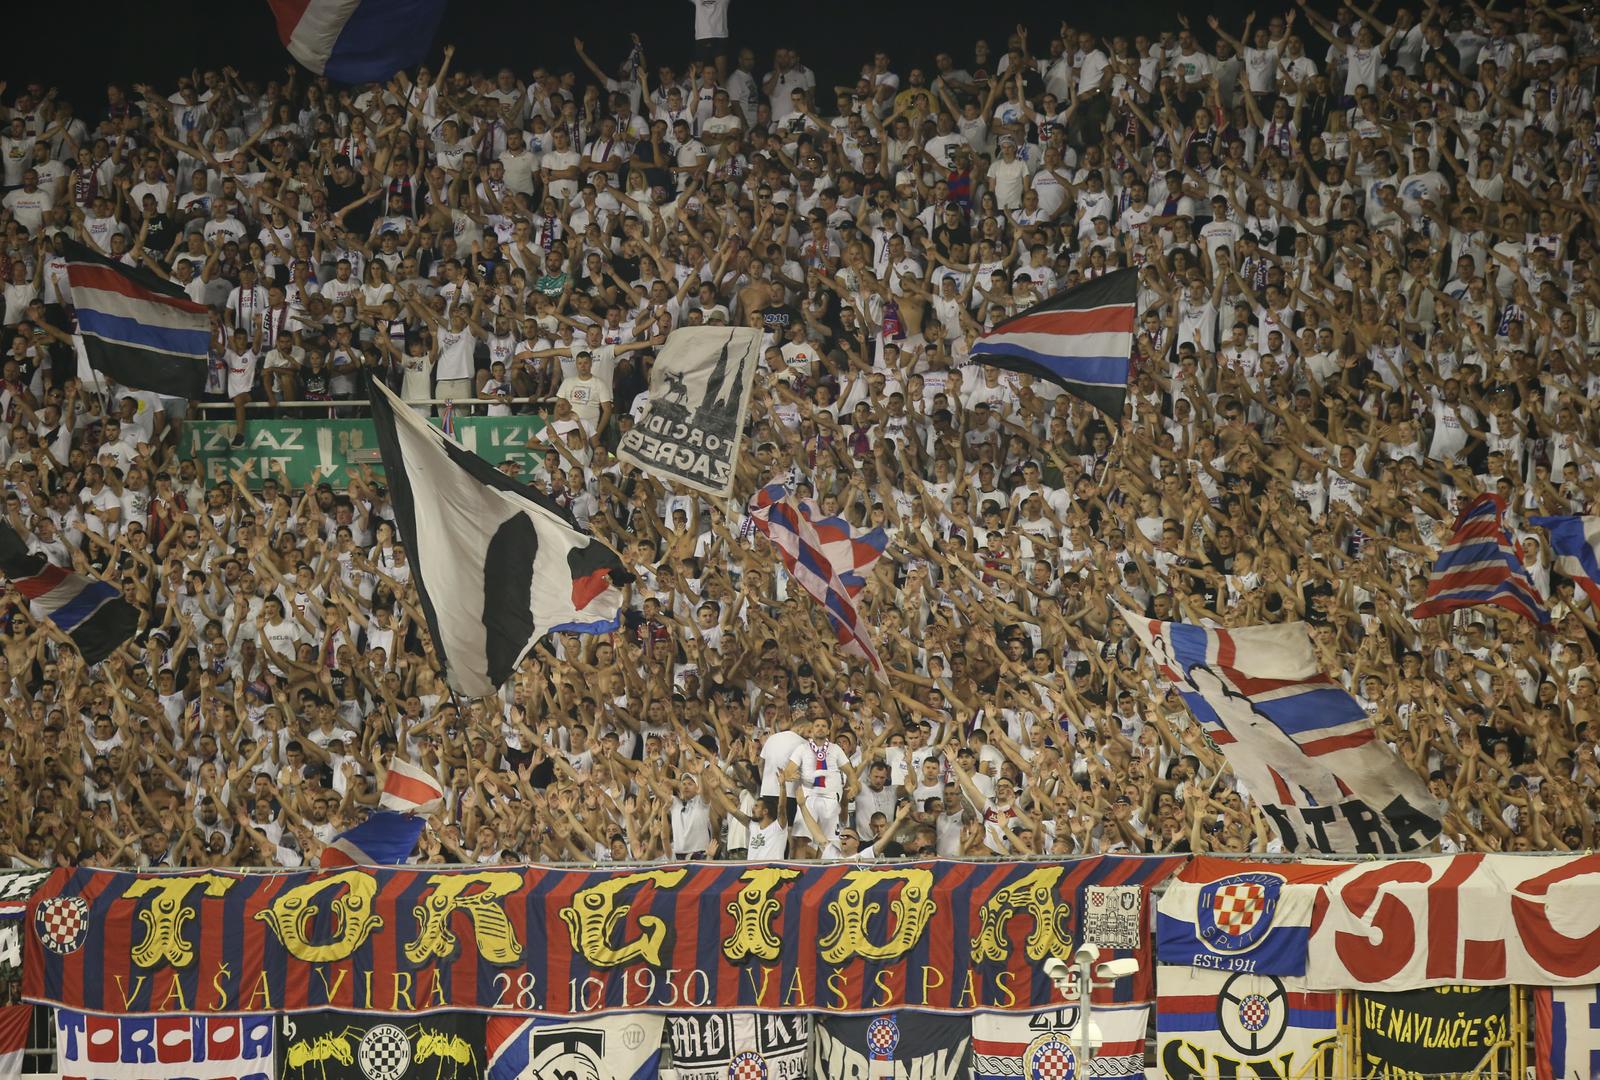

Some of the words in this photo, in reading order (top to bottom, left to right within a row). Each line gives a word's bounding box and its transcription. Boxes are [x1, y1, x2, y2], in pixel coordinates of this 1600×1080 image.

[207, 457, 292, 479] EXIT
[121, 866, 1074, 968] TORCIDA
[114, 961, 274, 1011] VAŠA
[315, 967, 449, 1010] VIRA
[492, 972, 544, 1010] 28.
[567, 976, 604, 1013] 10.
[620, 967, 712, 1009] 1950.
[57, 1009, 275, 1064] TORCIDA
[365, 1028, 405, 1046] HAJDUK
[1364, 998, 1387, 1037] UZ
[1387, 1007, 1482, 1049] NAVIJAČE
[731, 1052, 764, 1069] HAJDUK
[1035, 1042, 1074, 1058] HAJDUK
